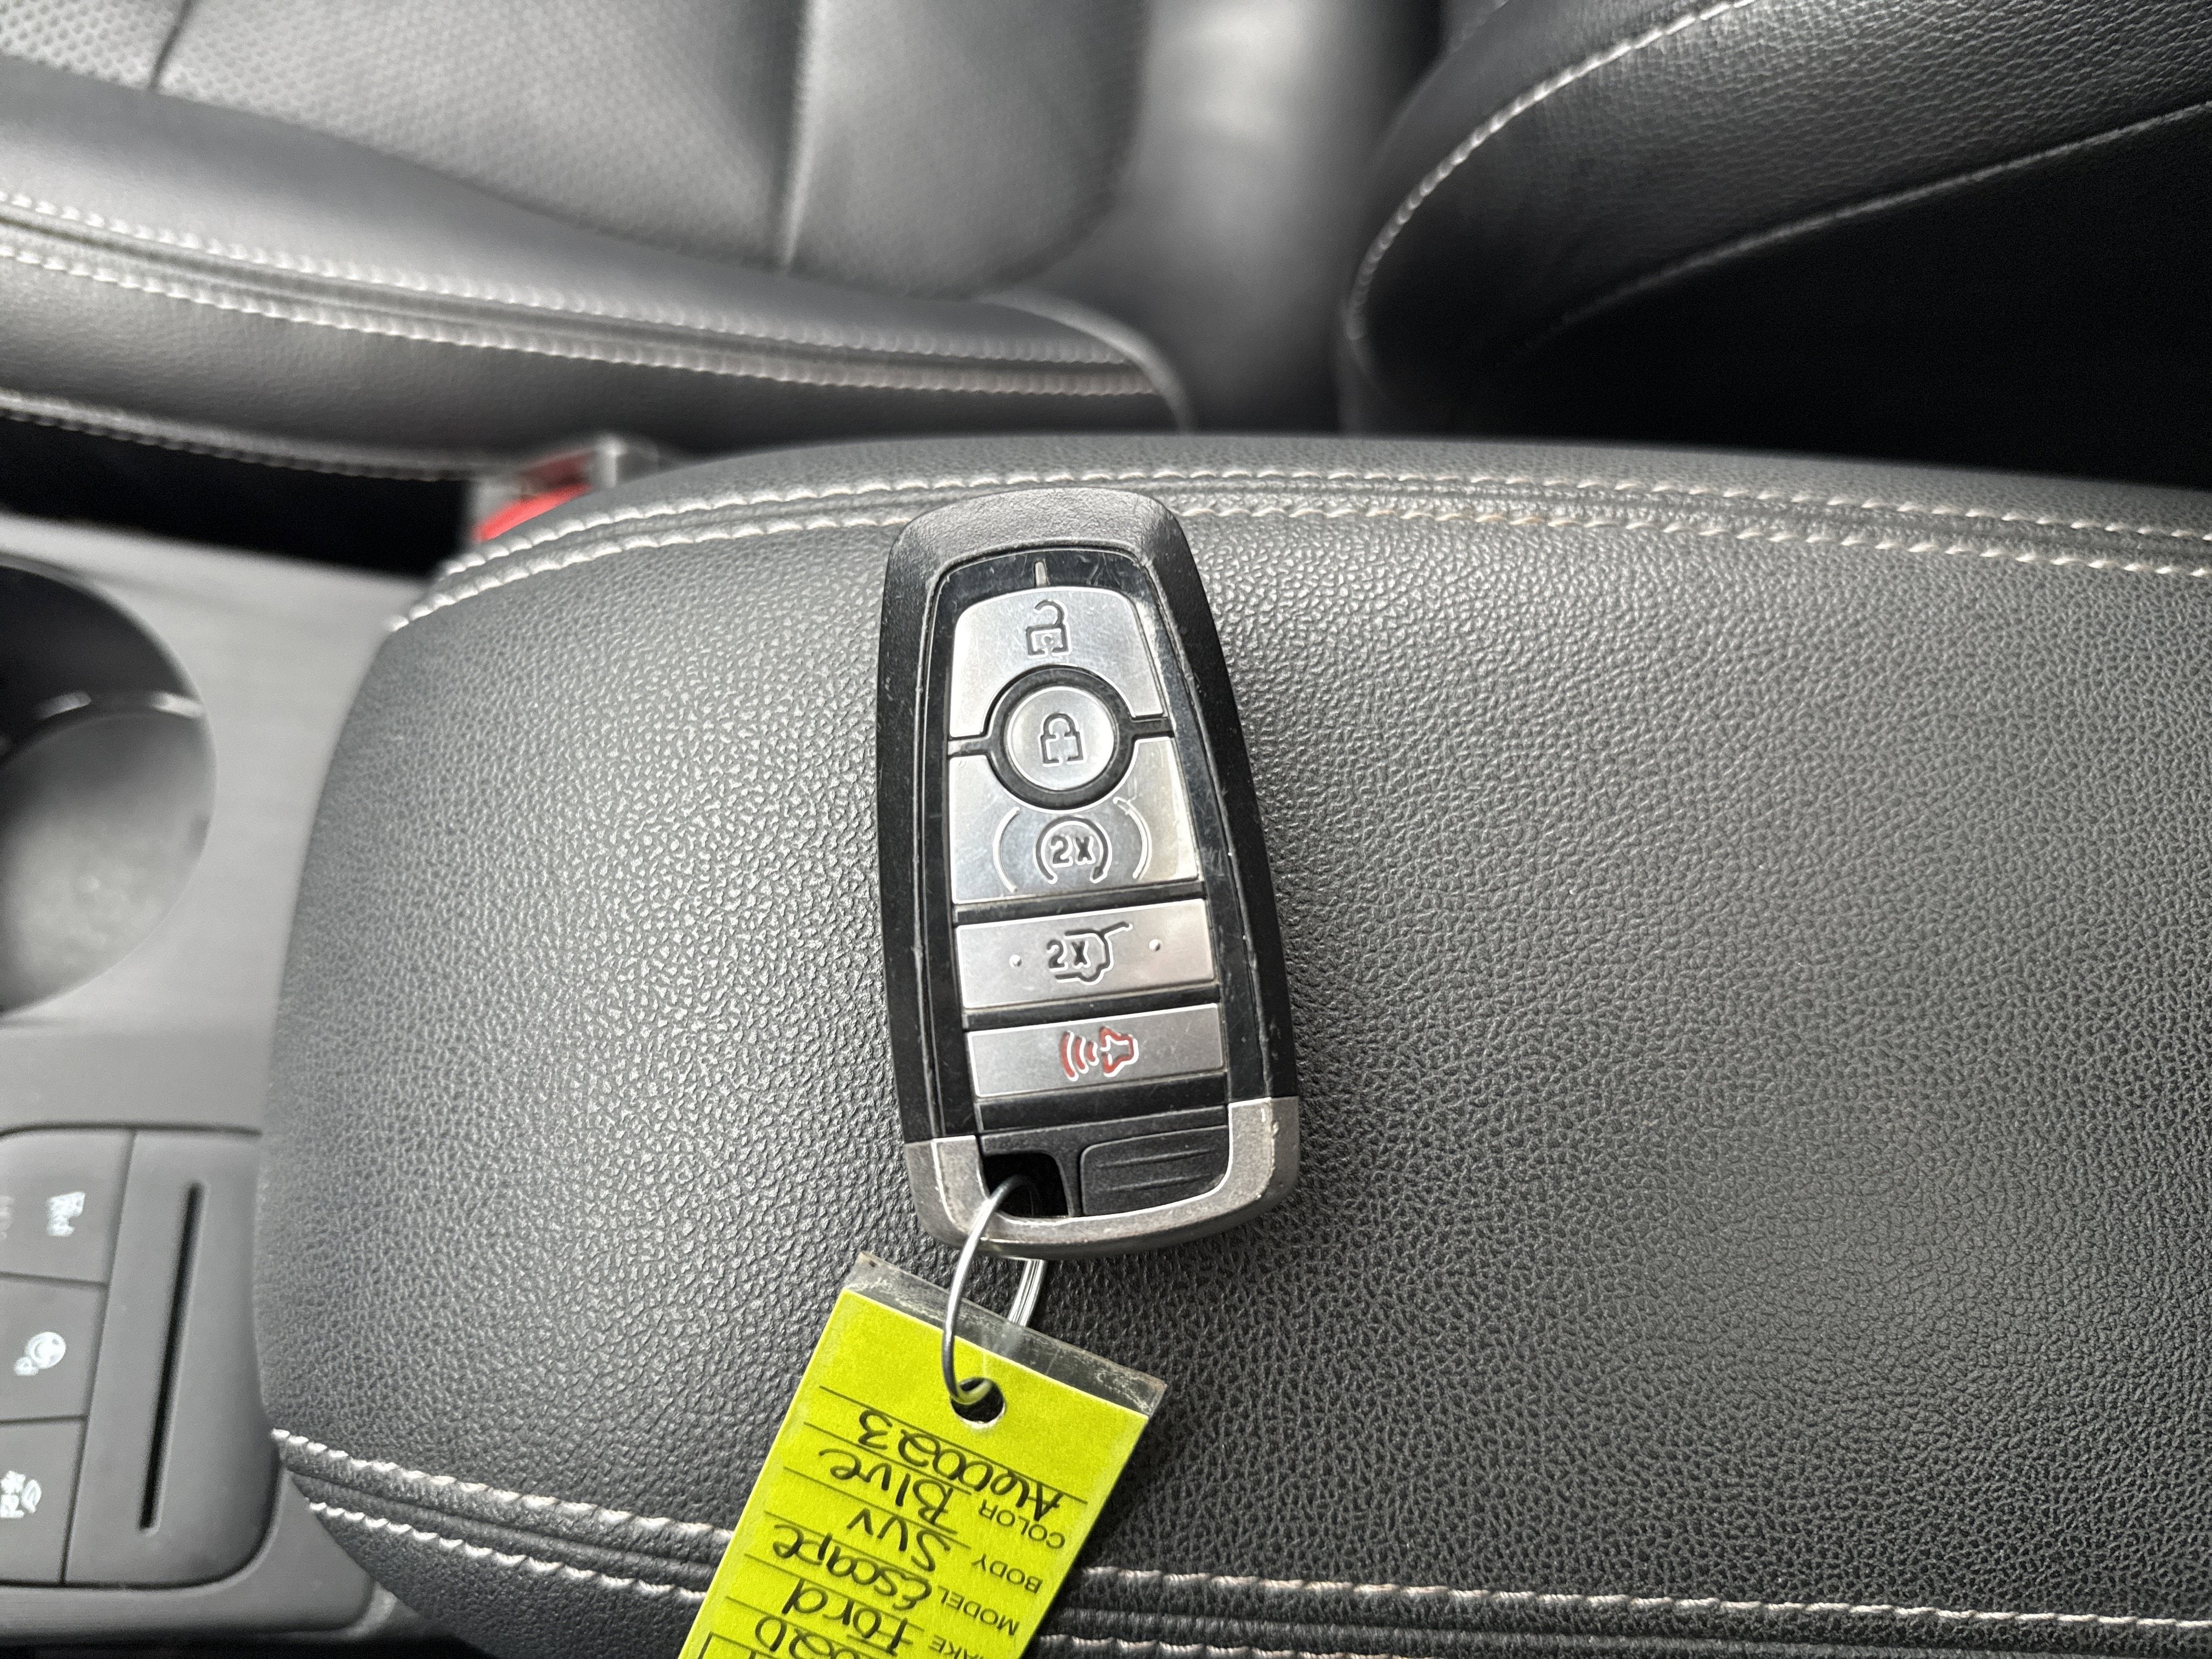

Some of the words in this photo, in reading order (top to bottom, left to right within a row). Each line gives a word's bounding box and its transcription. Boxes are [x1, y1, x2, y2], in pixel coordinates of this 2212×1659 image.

[1049, 834, 1097, 867] 2X
[1046, 939, 1091, 973] 2X
[819, 1448, 957, 1535] Blue
[978, 1499, 1066, 1549] COLOR
[772, 1524, 933, 1611] Escape
[971, 1553, 1043, 1594] BODY
[781, 1578, 913, 1657] Ford
[938, 1585, 1020, 1637] MODEL
[928, 1634, 985, 1659] AKE
